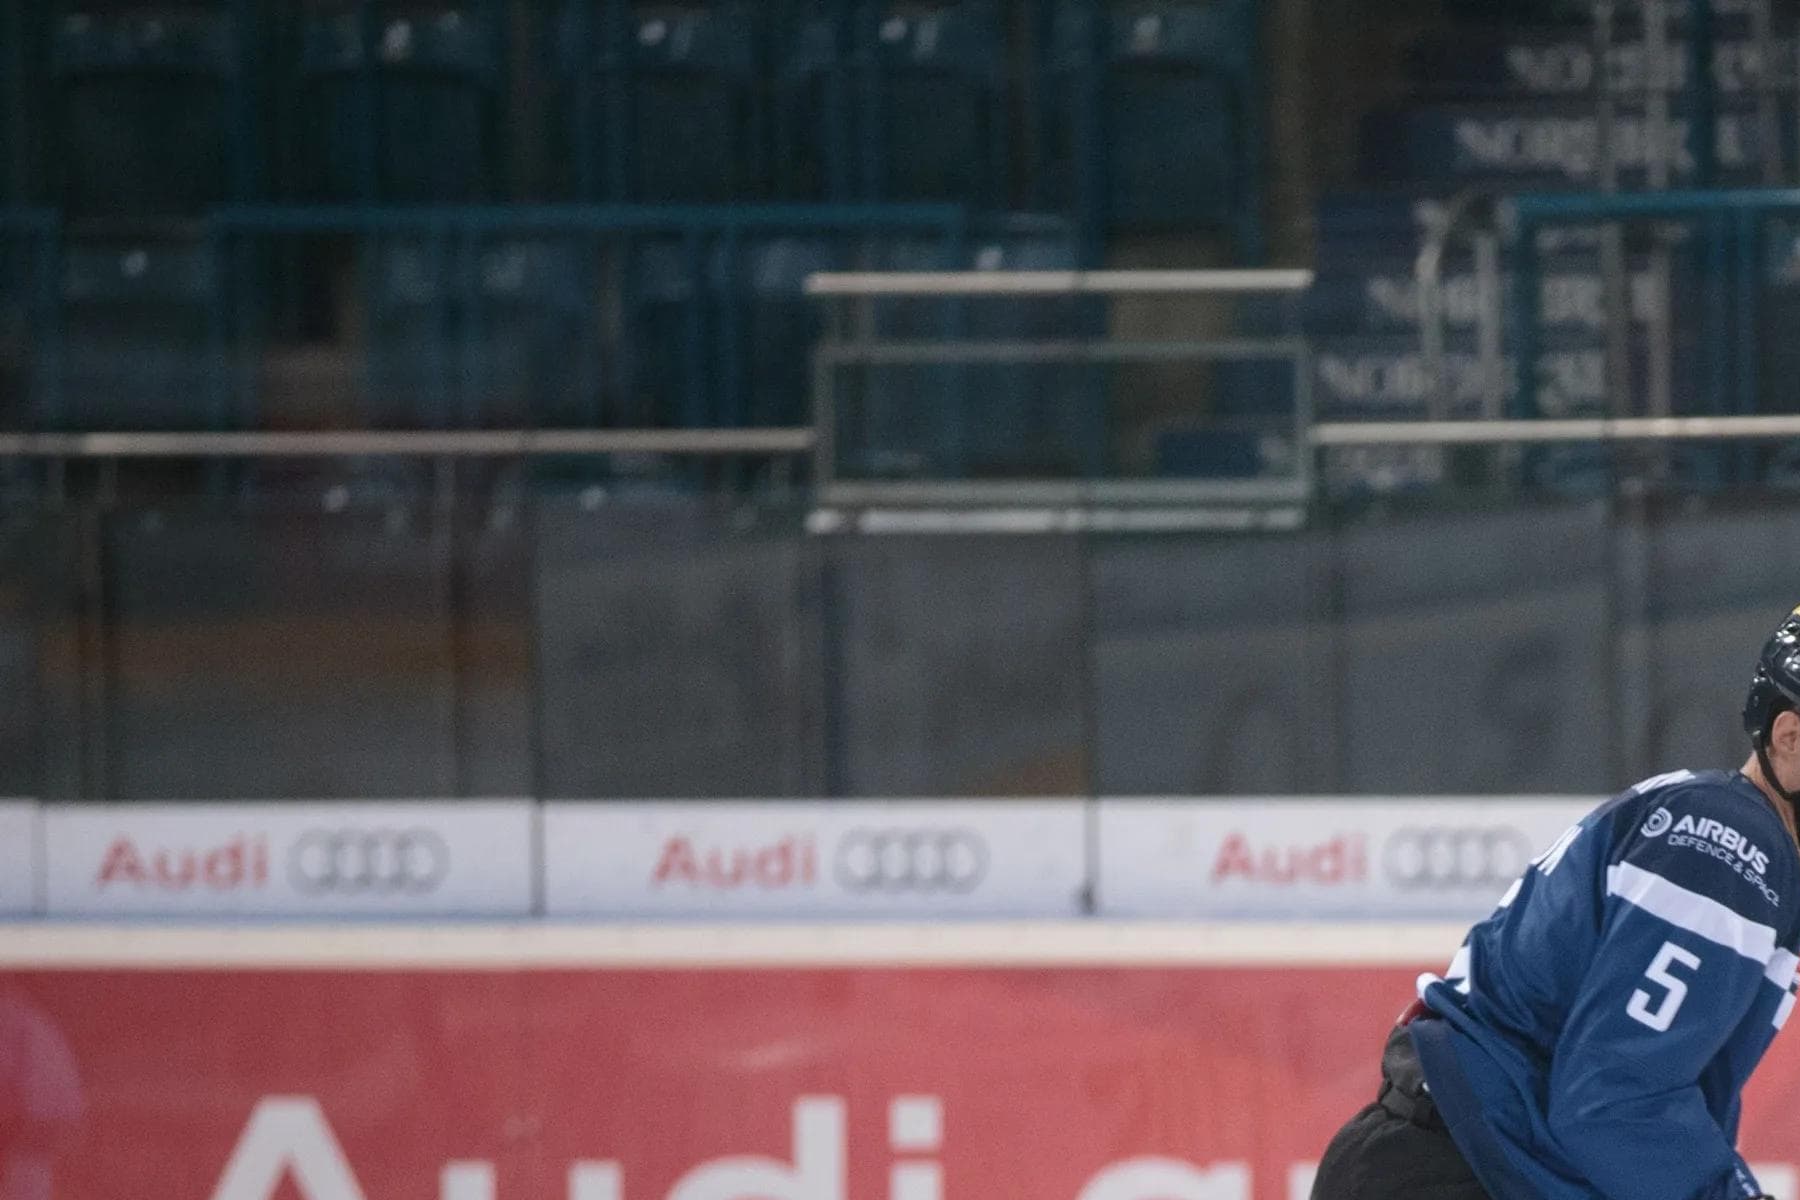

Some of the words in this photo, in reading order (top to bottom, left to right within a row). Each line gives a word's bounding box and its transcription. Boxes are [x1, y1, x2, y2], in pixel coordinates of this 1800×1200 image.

[94, 832, 270, 891] Audi
[649, 832, 819, 889] Audi
[1210, 830, 1369, 886] Audi
[1667, 834, 1735, 867] DEFENCE
[1731, 862, 1744, 875] &
[1672, 814, 1770, 875] AIRBUS
[1626, 942, 1701, 1032] 5
